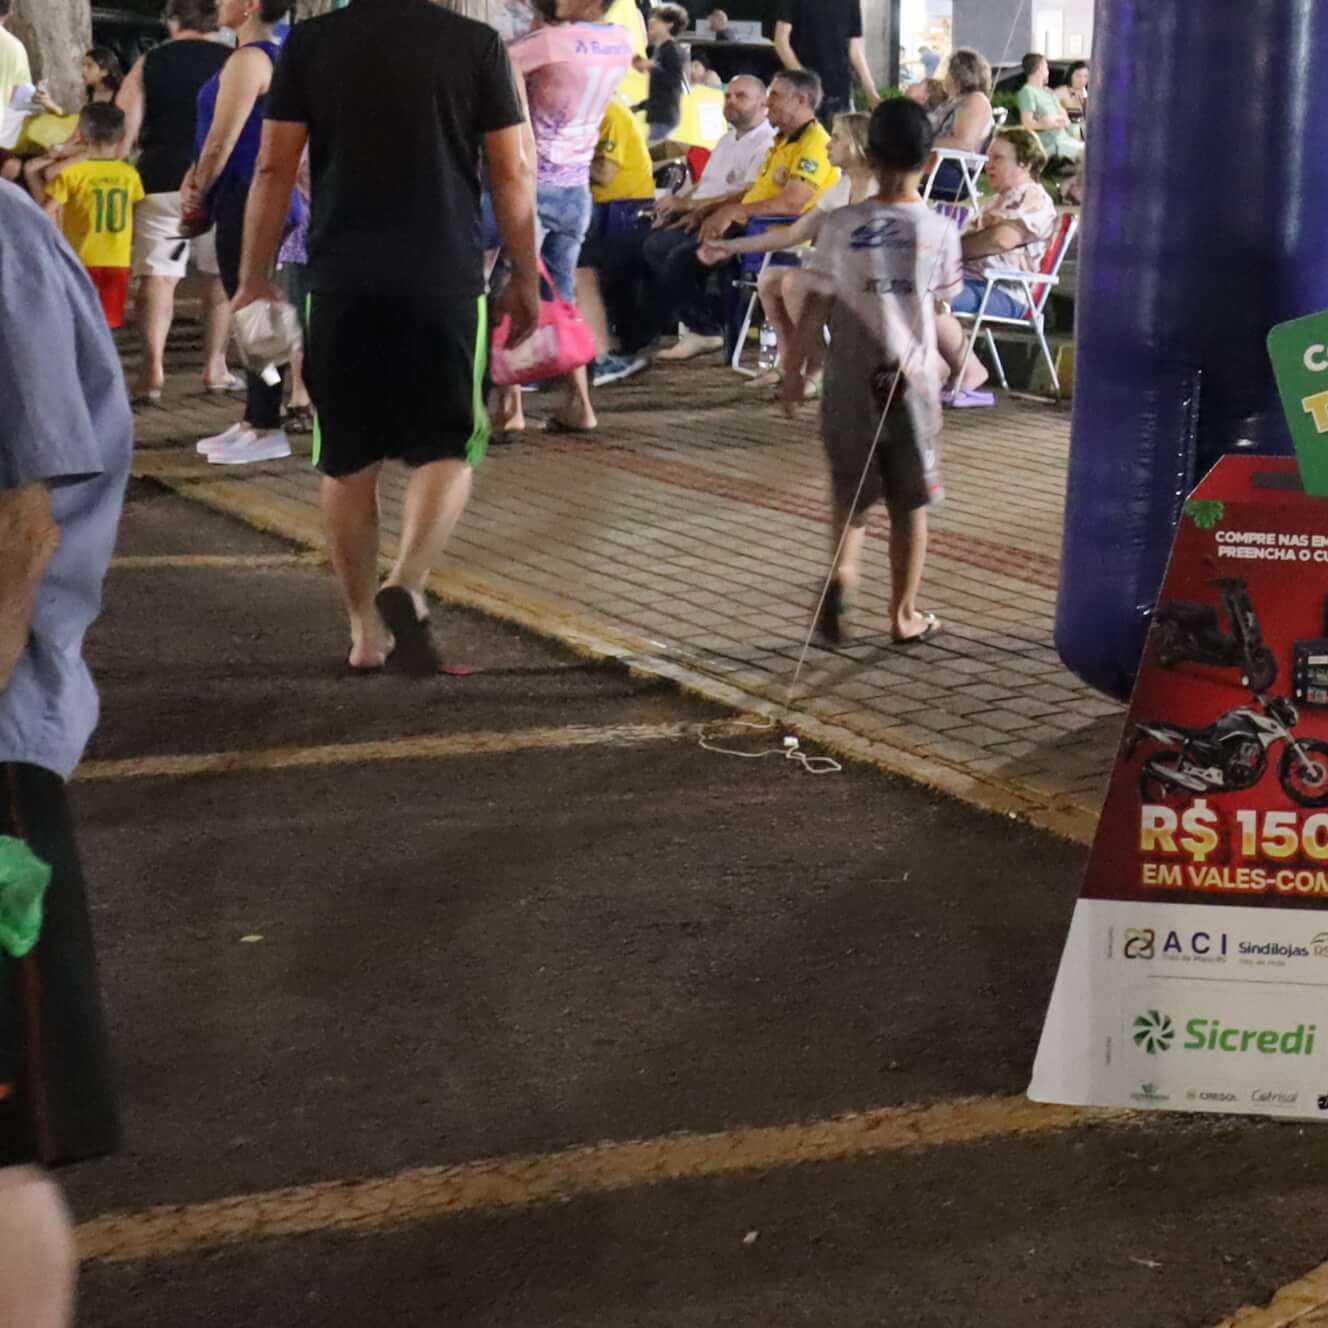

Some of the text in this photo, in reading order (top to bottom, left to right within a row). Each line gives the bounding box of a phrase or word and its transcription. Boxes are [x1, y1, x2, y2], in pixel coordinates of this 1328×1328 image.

[92, 188, 128, 233] 10
[1215, 530, 1276, 545] COMPRE
[1278, 533, 1309, 547] NAS
[1217, 545, 1297, 561] PREENCHA
[1299, 549, 1311, 562] O
[1140, 799, 1219, 862] R$
[1143, 863, 1183, 887] EM
[1163, 930, 1228, 955] ACI
[1238, 941, 1310, 958] Sindilojas
[1184, 1018, 1317, 1055] Sicredi
